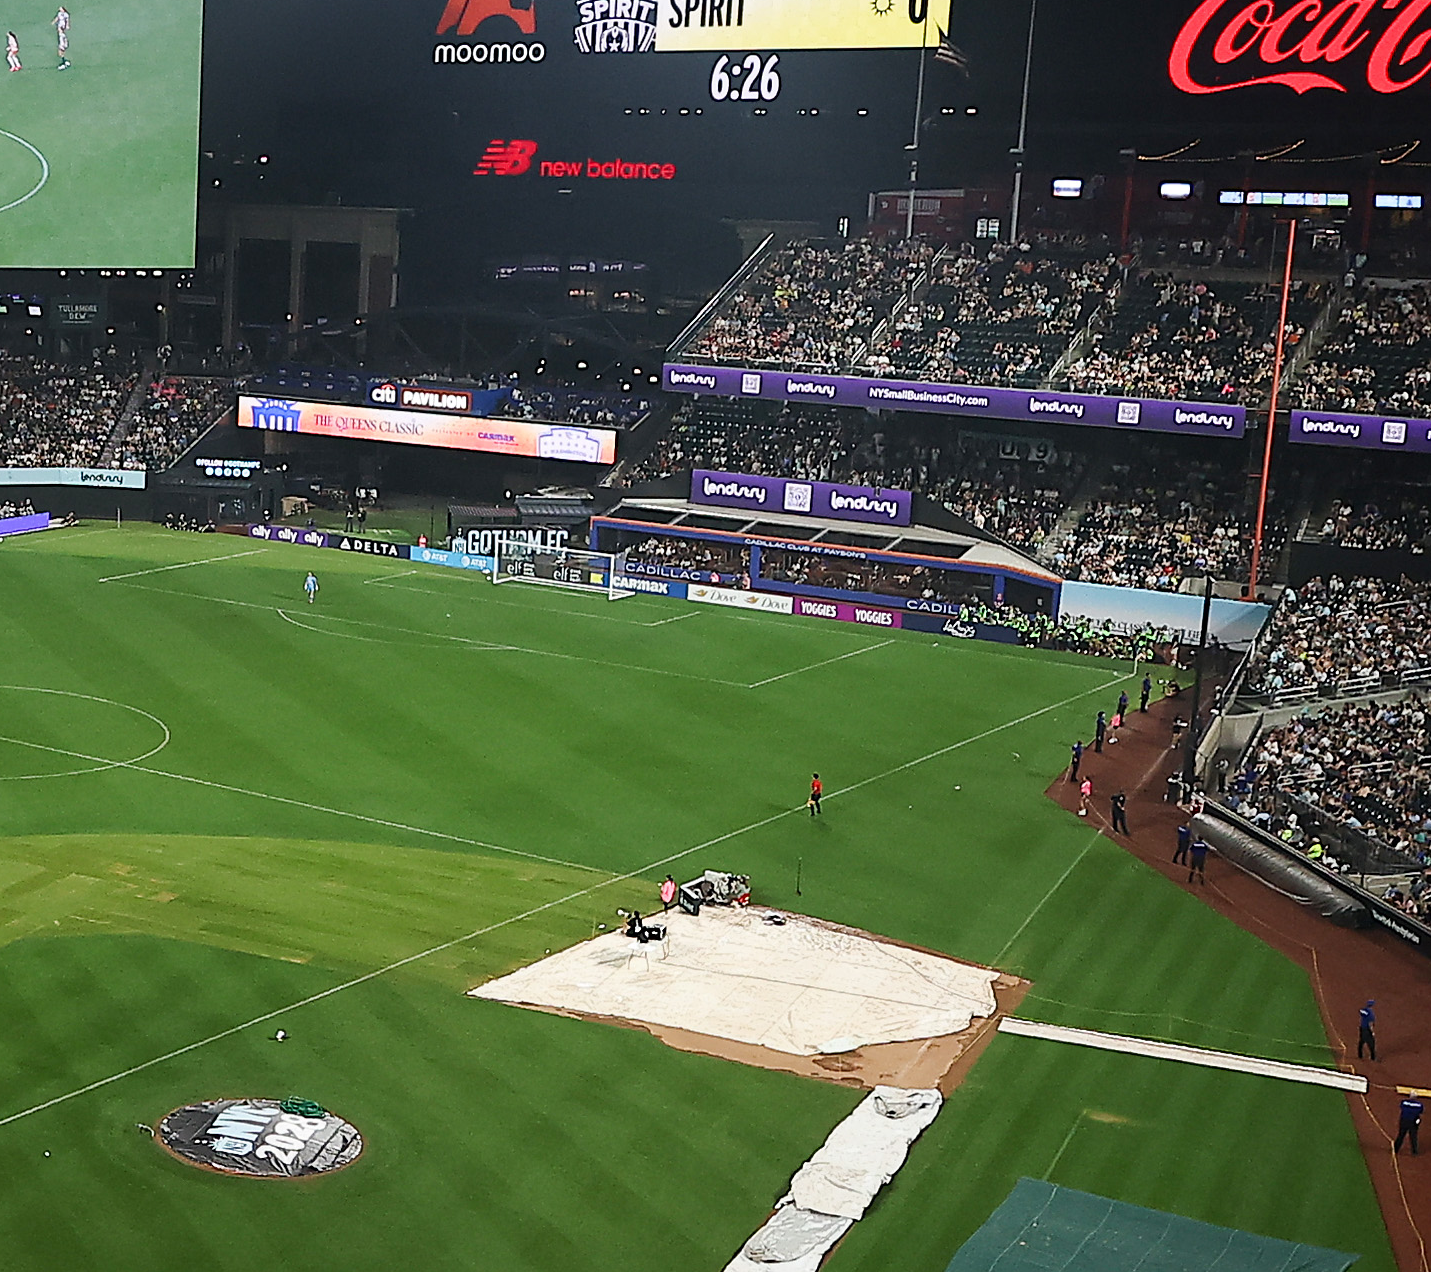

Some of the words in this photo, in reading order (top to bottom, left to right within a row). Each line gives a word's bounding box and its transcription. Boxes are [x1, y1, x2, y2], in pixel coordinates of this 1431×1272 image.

[434, 41, 547, 65] moomoo
[709, 53, 782, 103] 6:26
[540, 161, 583, 180] new
[586, 156, 677, 182] balance
[68, 312, 87, 320] DEW
[371, 386, 397, 404] citi
[403, 390, 468, 410] PAVILION
[868, 387, 988, 408] NYSmallBusinessCity.com
[313, 414, 334, 428] THE
[335, 416, 377, 432] QUEENS
[379, 419, 424, 436] CLASSIC
[703, 477, 767, 503] lendistry
[830, 490, 898, 518] lendistry
[252, 523, 272, 541] ally
[278, 528, 298, 545] ally
[304, 532, 324, 548] ally
[546, 528, 569, 552] FC
[744, 538, 783, 550] CADILLAC
[785, 542, 809, 552] CLUB
[810, 545, 822, 554] AT
[353, 540, 398, 557] DELTA
[431, 551, 449, 562] AT&T
[470, 557, 488, 568] AT&T
[506, 561, 524, 576] elf
[553, 567, 570, 582] elf
[625, 562, 702, 582] CADILLAC
[707, 589, 738, 605] Dove
[758, 595, 790, 611] Dove
[800, 600, 838, 618] YOGGIES
[854, 607, 893, 625] YOGGIES
[255, 1113, 329, 1165] 2028
